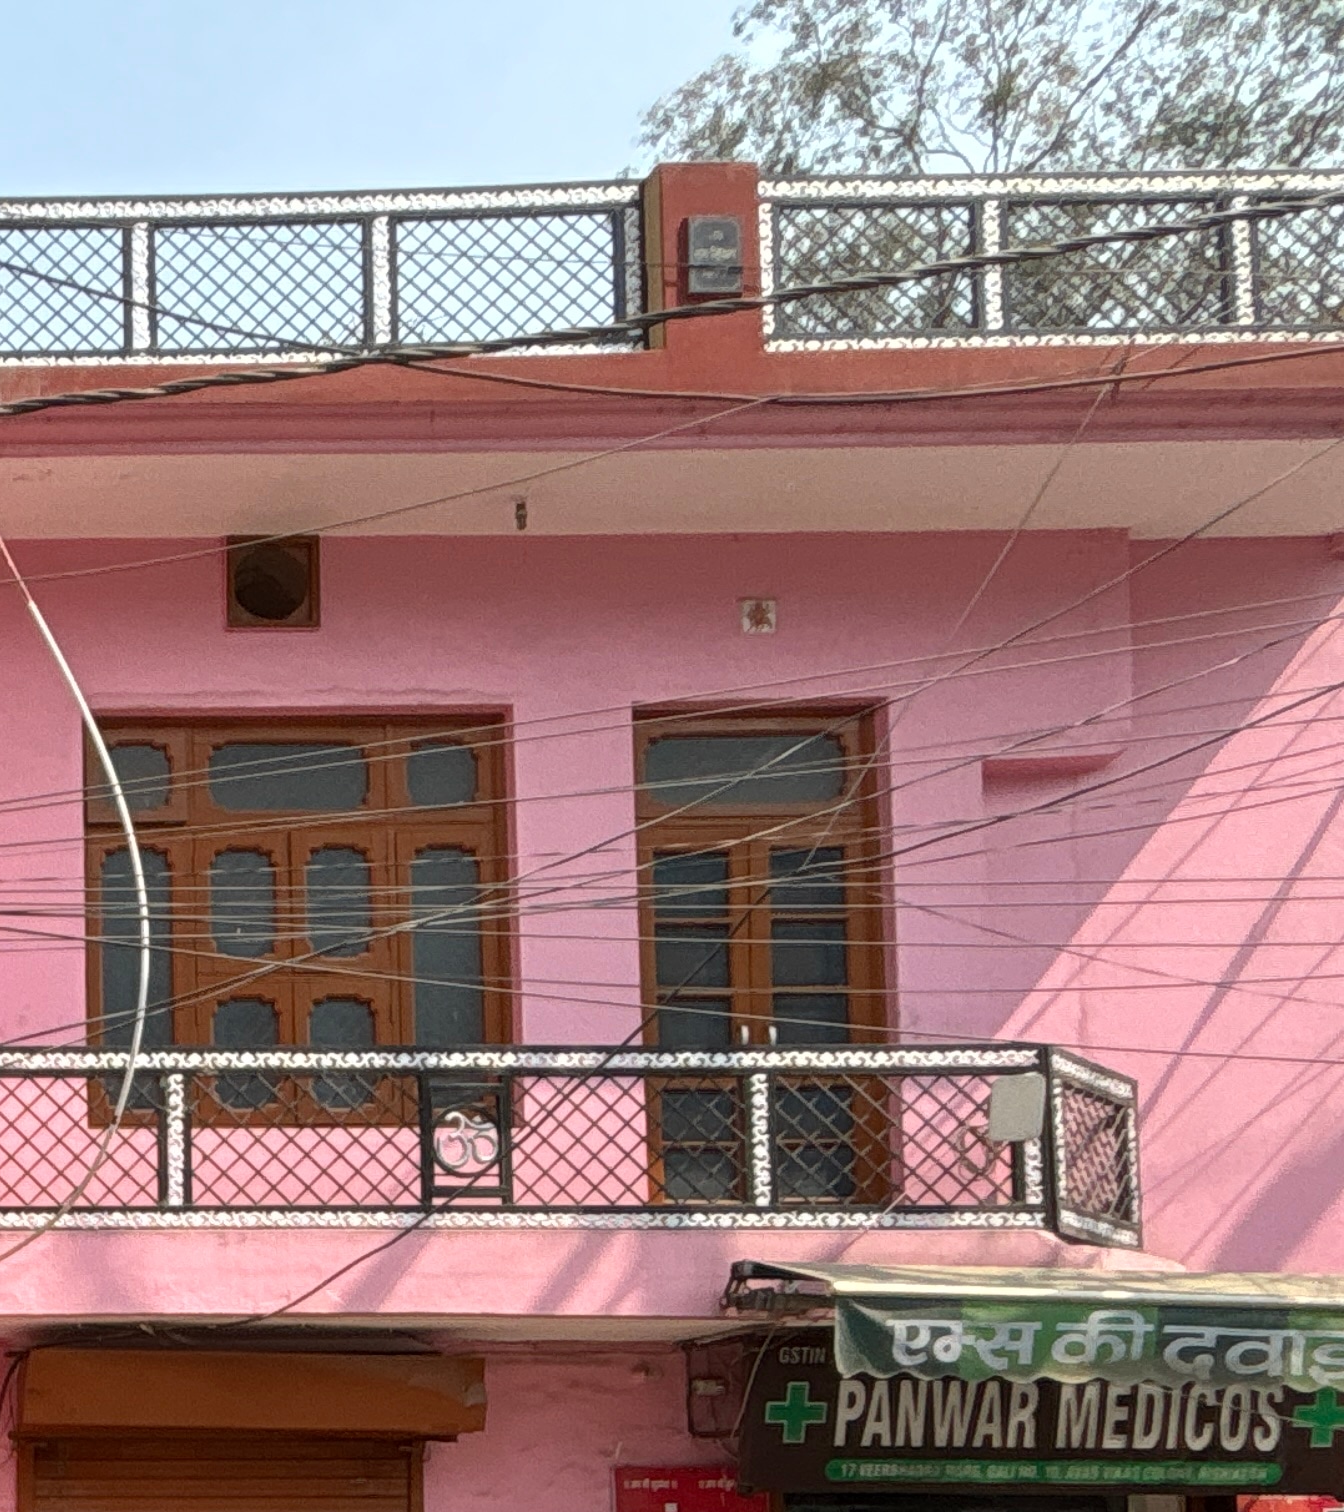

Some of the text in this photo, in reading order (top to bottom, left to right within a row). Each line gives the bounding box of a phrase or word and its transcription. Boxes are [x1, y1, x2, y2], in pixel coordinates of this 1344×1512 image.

[886, 1319, 1042, 1371] एम्स
[1050, 1310, 1154, 1365] की
[833, 1381, 1284, 1453] PANWAR MEDICOS
